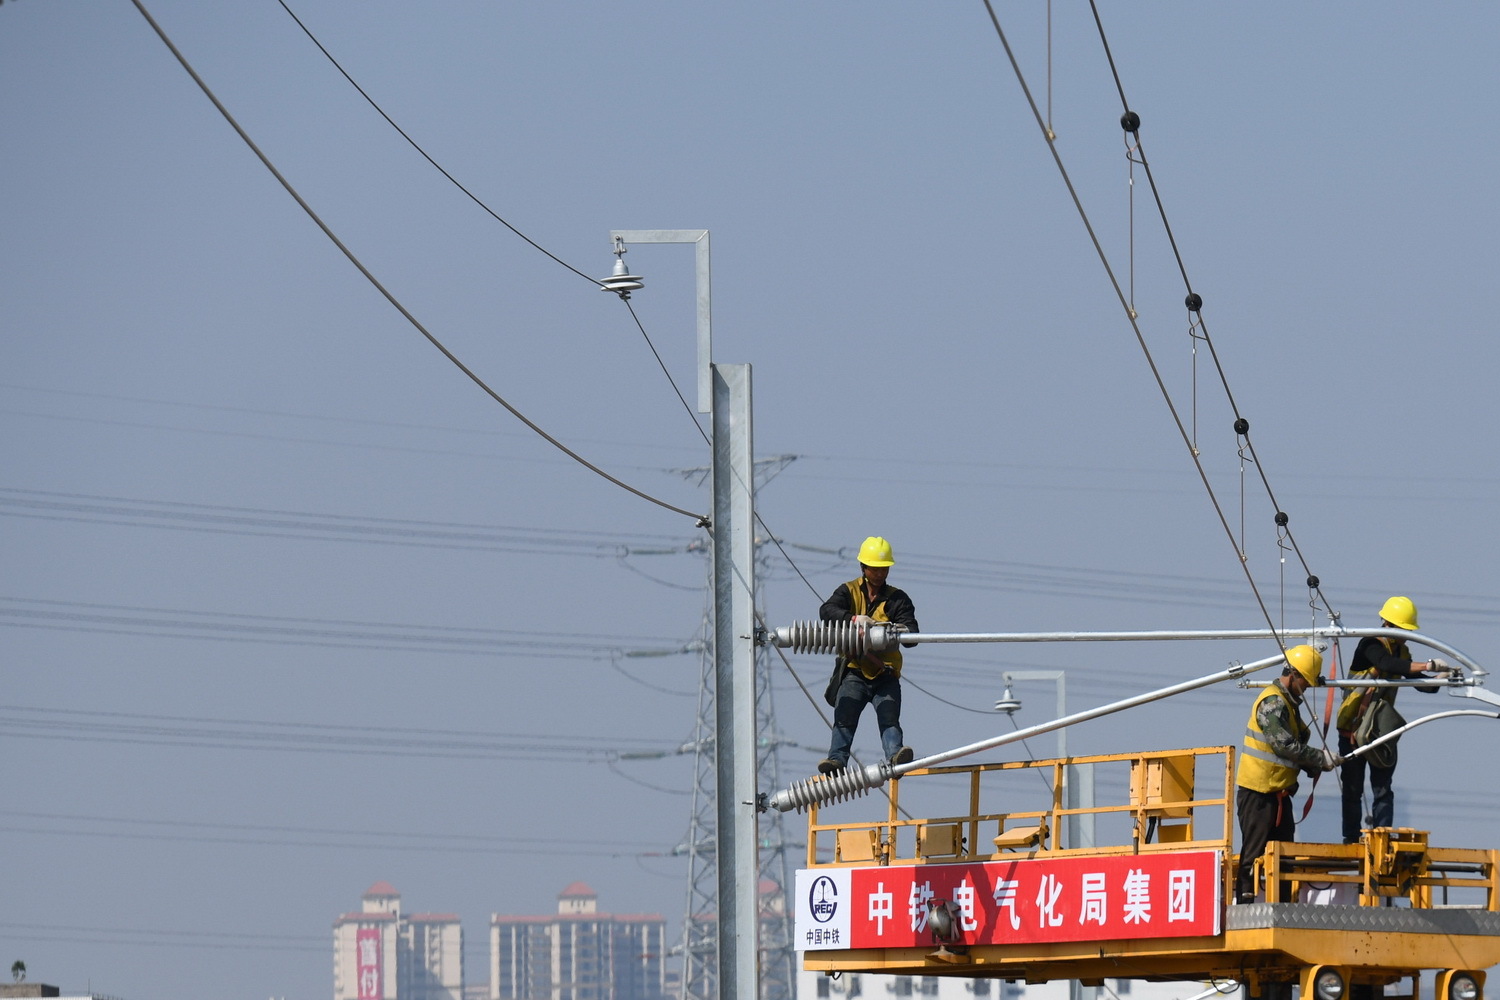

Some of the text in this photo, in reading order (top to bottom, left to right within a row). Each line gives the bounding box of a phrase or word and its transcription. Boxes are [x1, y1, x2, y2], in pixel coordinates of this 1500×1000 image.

[868, 869, 1195, 936] 中铁电气化局集团
[807, 928, 840, 945] 中国中铁
